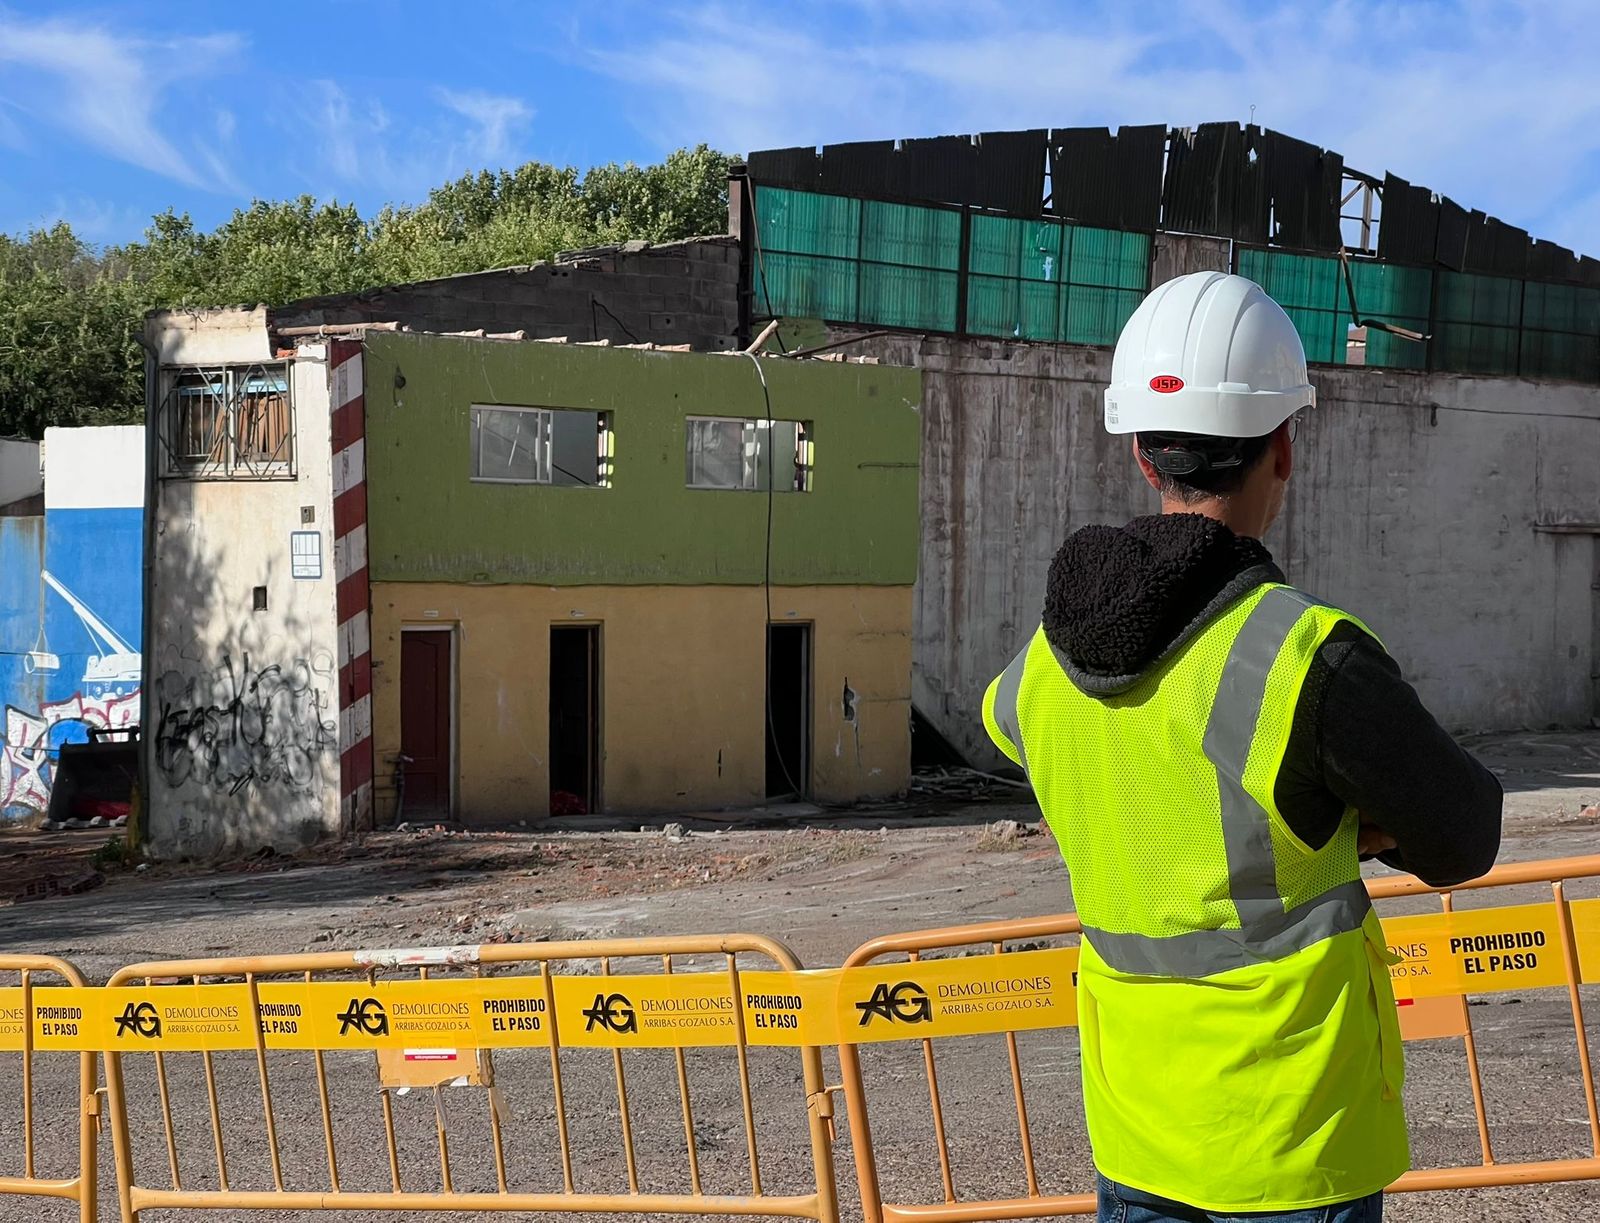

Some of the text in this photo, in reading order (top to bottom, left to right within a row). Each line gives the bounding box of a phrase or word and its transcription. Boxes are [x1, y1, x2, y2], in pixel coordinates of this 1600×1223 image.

[1155, 379, 1179, 389] JSP
[1450, 930, 1545, 954] PROHIBIDO
[1410, 965, 1432, 976] S.A.
[1464, 953, 1537, 974] EL PASO
[938, 976, 1051, 998] DEMOLICIONES
[392, 1002, 470, 1016] DEMOLICIONES
[483, 998, 546, 1014] PROHIBIDO
[641, 996, 733, 1013] DEMOLICIONES
[747, 994, 802, 1010] PROHIBIDO
[855, 981, 933, 1027] AG
[940, 997, 1055, 1015] ARRIBAS GOZALO S.A.
[36, 1006, 82, 1021] PROHIBIDO
[165, 1005, 239, 1019] DEMOLICIONES
[258, 1003, 302, 1017] ROHIBIDO
[337, 998, 390, 1036] AG
[582, 993, 638, 1034] AG
[114, 1002, 163, 1038] AG
[260, 1020, 298, 1034] EL PASO
[394, 1020, 471, 1031] ARRIBAS GOZALO S.A.
[493, 1016, 540, 1031] EL PASO
[643, 1015, 736, 1028] ARRIBAS GOZALO S.A.
[755, 1014, 798, 1029] EL PASO
[42, 1023, 78, 1036] EL PASO
[166, 1022, 241, 1034] ARRIBAS GOZALO S.A.
